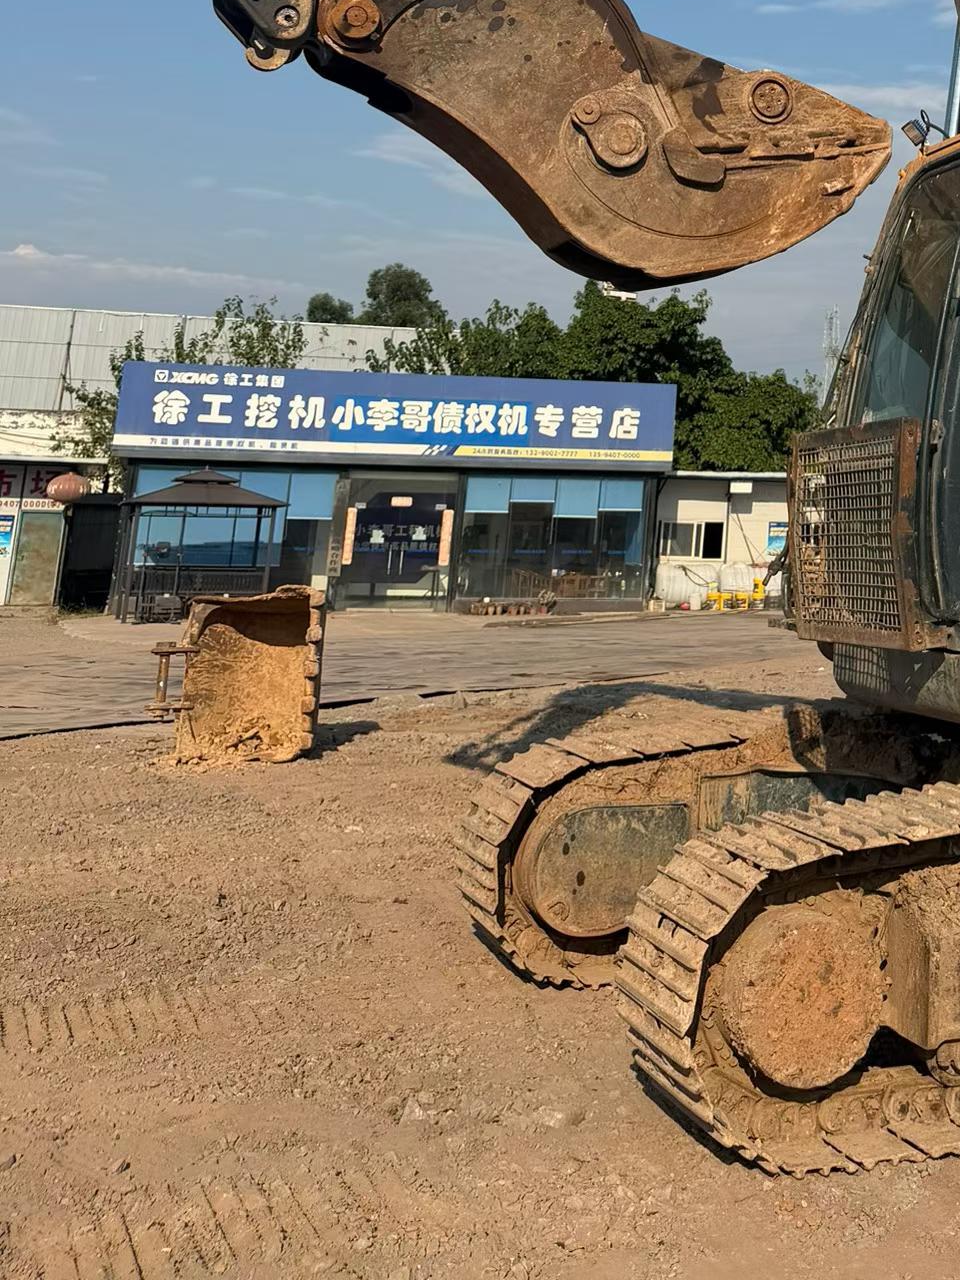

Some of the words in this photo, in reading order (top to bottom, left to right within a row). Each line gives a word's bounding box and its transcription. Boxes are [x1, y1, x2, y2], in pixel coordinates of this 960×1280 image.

[169, 371, 219, 385] XCMG
[224, 372, 285, 389] 徐工集团
[152, 389, 641, 440] 徐工挖机小李哥债权机专营店
